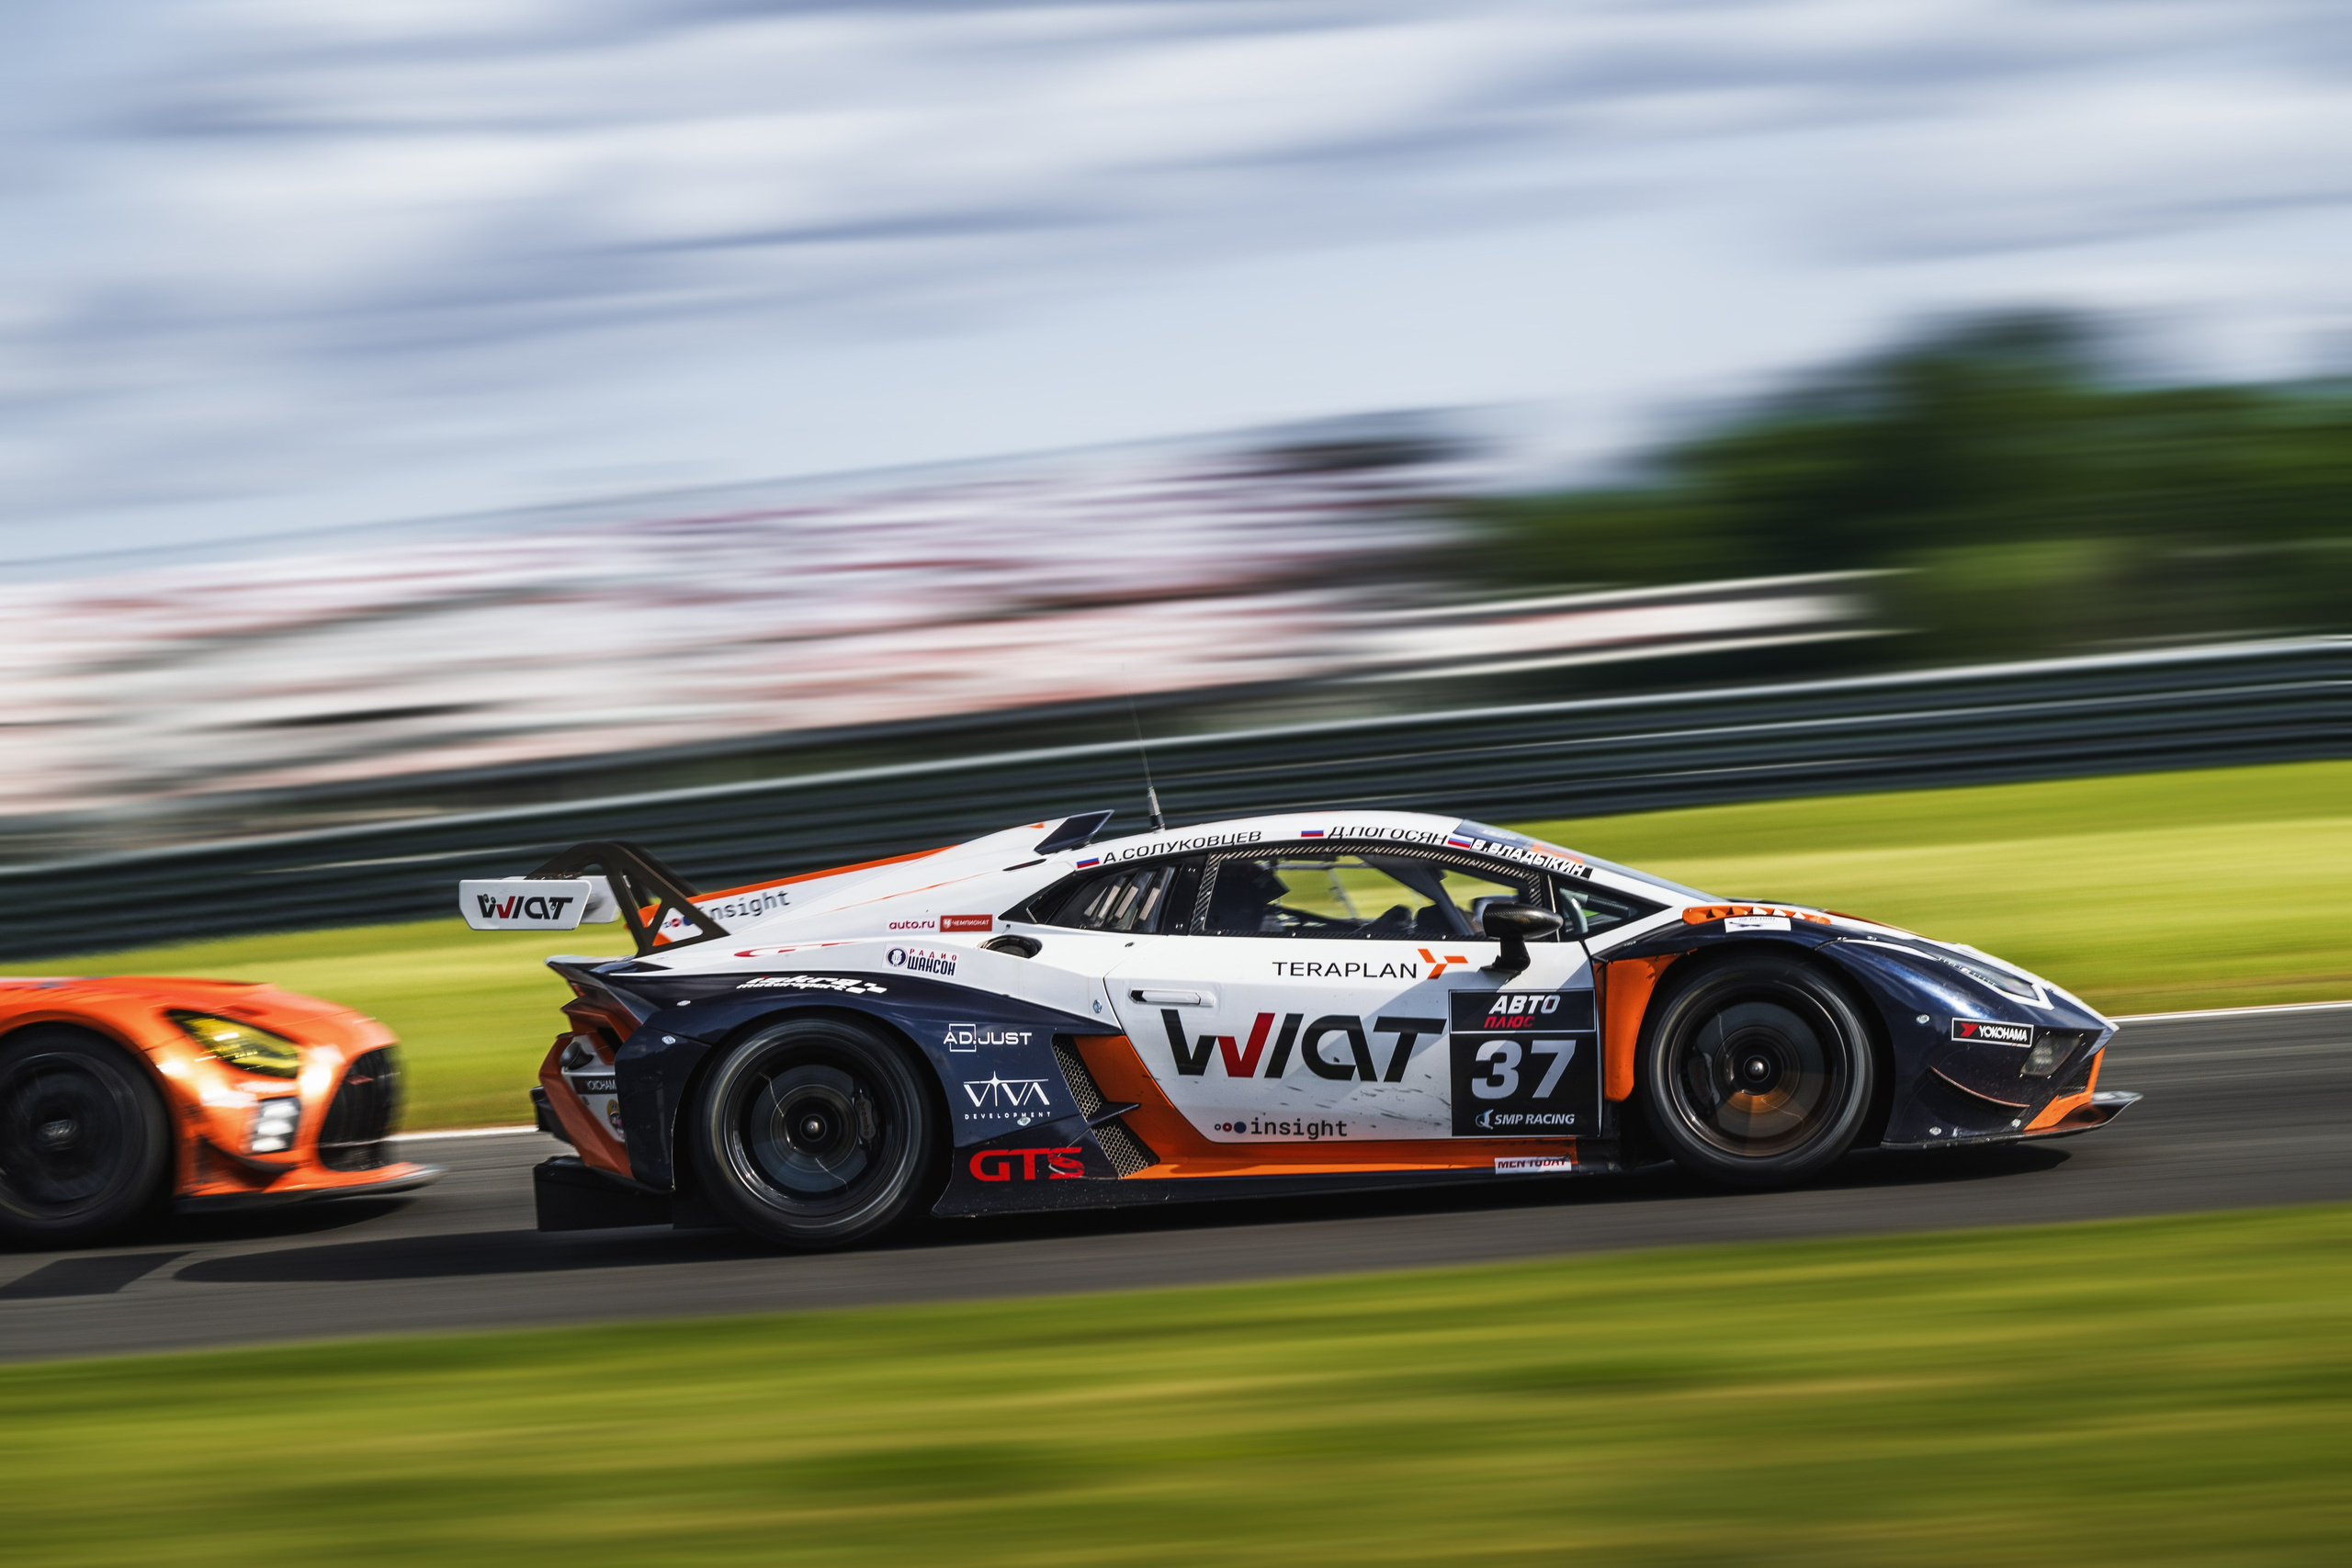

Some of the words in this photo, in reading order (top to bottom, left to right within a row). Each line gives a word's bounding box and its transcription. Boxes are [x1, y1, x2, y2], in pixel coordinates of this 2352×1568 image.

[1328, 826, 1448, 845] Д.ПОГОСЯН
[1102, 830, 1261, 864] А.СОЛУКОВЦЕВ
[1472, 839, 1586, 876] В.ВЛАДЫКИН
[477, 894, 573, 919] WIAT
[888, 919, 935, 930] auto.ru
[907, 955, 956, 976] ШАНСОН
[910, 948, 957, 962] РАДИО
[1272, 961, 1417, 979] TERAPLAN
[1488, 994, 1561, 1015] АВТО
[1484, 1015, 1535, 1029] ПЛЮС
[1978, 1025, 2028, 1042] YOKOHAMA
[1160, 1009, 1447, 1082] WIAT
[1472, 1039, 1577, 1100] 37
[964, 1071, 1050, 1107] VIVA
[964, 1111, 1051, 1121] DEVELOPMENT
[1494, 1113, 1523, 1125] SMP
[1525, 1113, 1575, 1125] RACING
[1250, 1117, 1348, 1140] insight
[969, 1146, 1085, 1182] GTS
[1498, 1160, 1525, 1169] MEN
